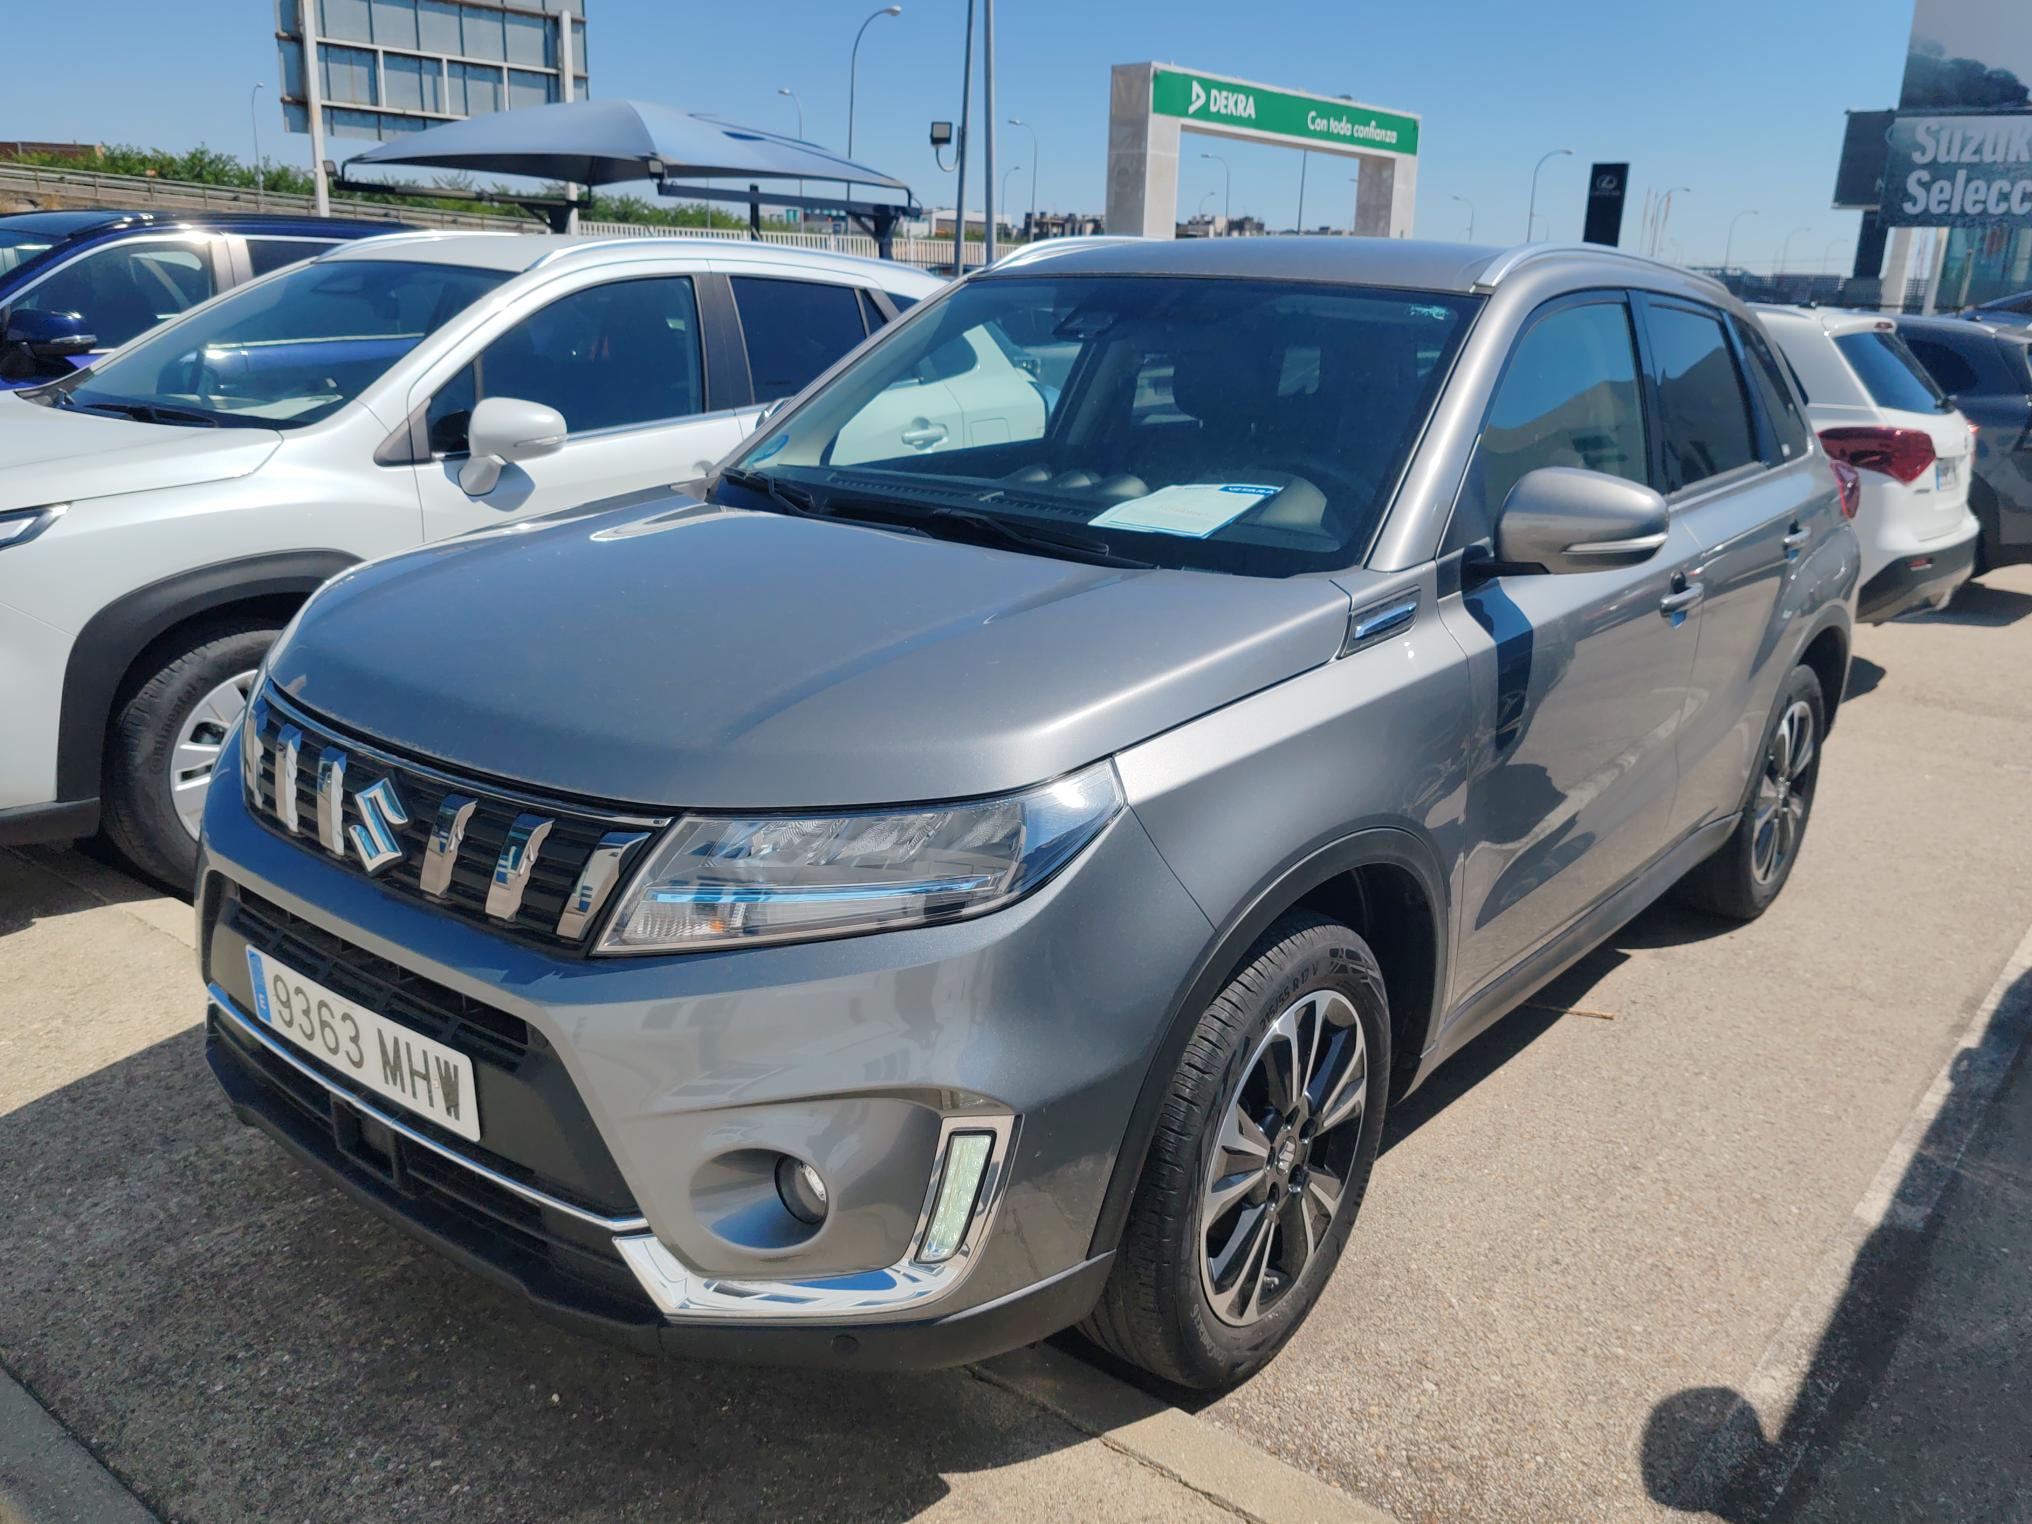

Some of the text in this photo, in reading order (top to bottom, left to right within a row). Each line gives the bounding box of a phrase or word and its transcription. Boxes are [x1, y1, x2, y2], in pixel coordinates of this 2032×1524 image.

[1210, 88, 1256, 120] DEKRA
[1307, 110, 1398, 144] Con toda confianza
[1902, 168, 2032, 216] Selecc
[1259, 985, 1290, 1030] 215/55
[273, 973, 461, 1122] 9363 MHW
